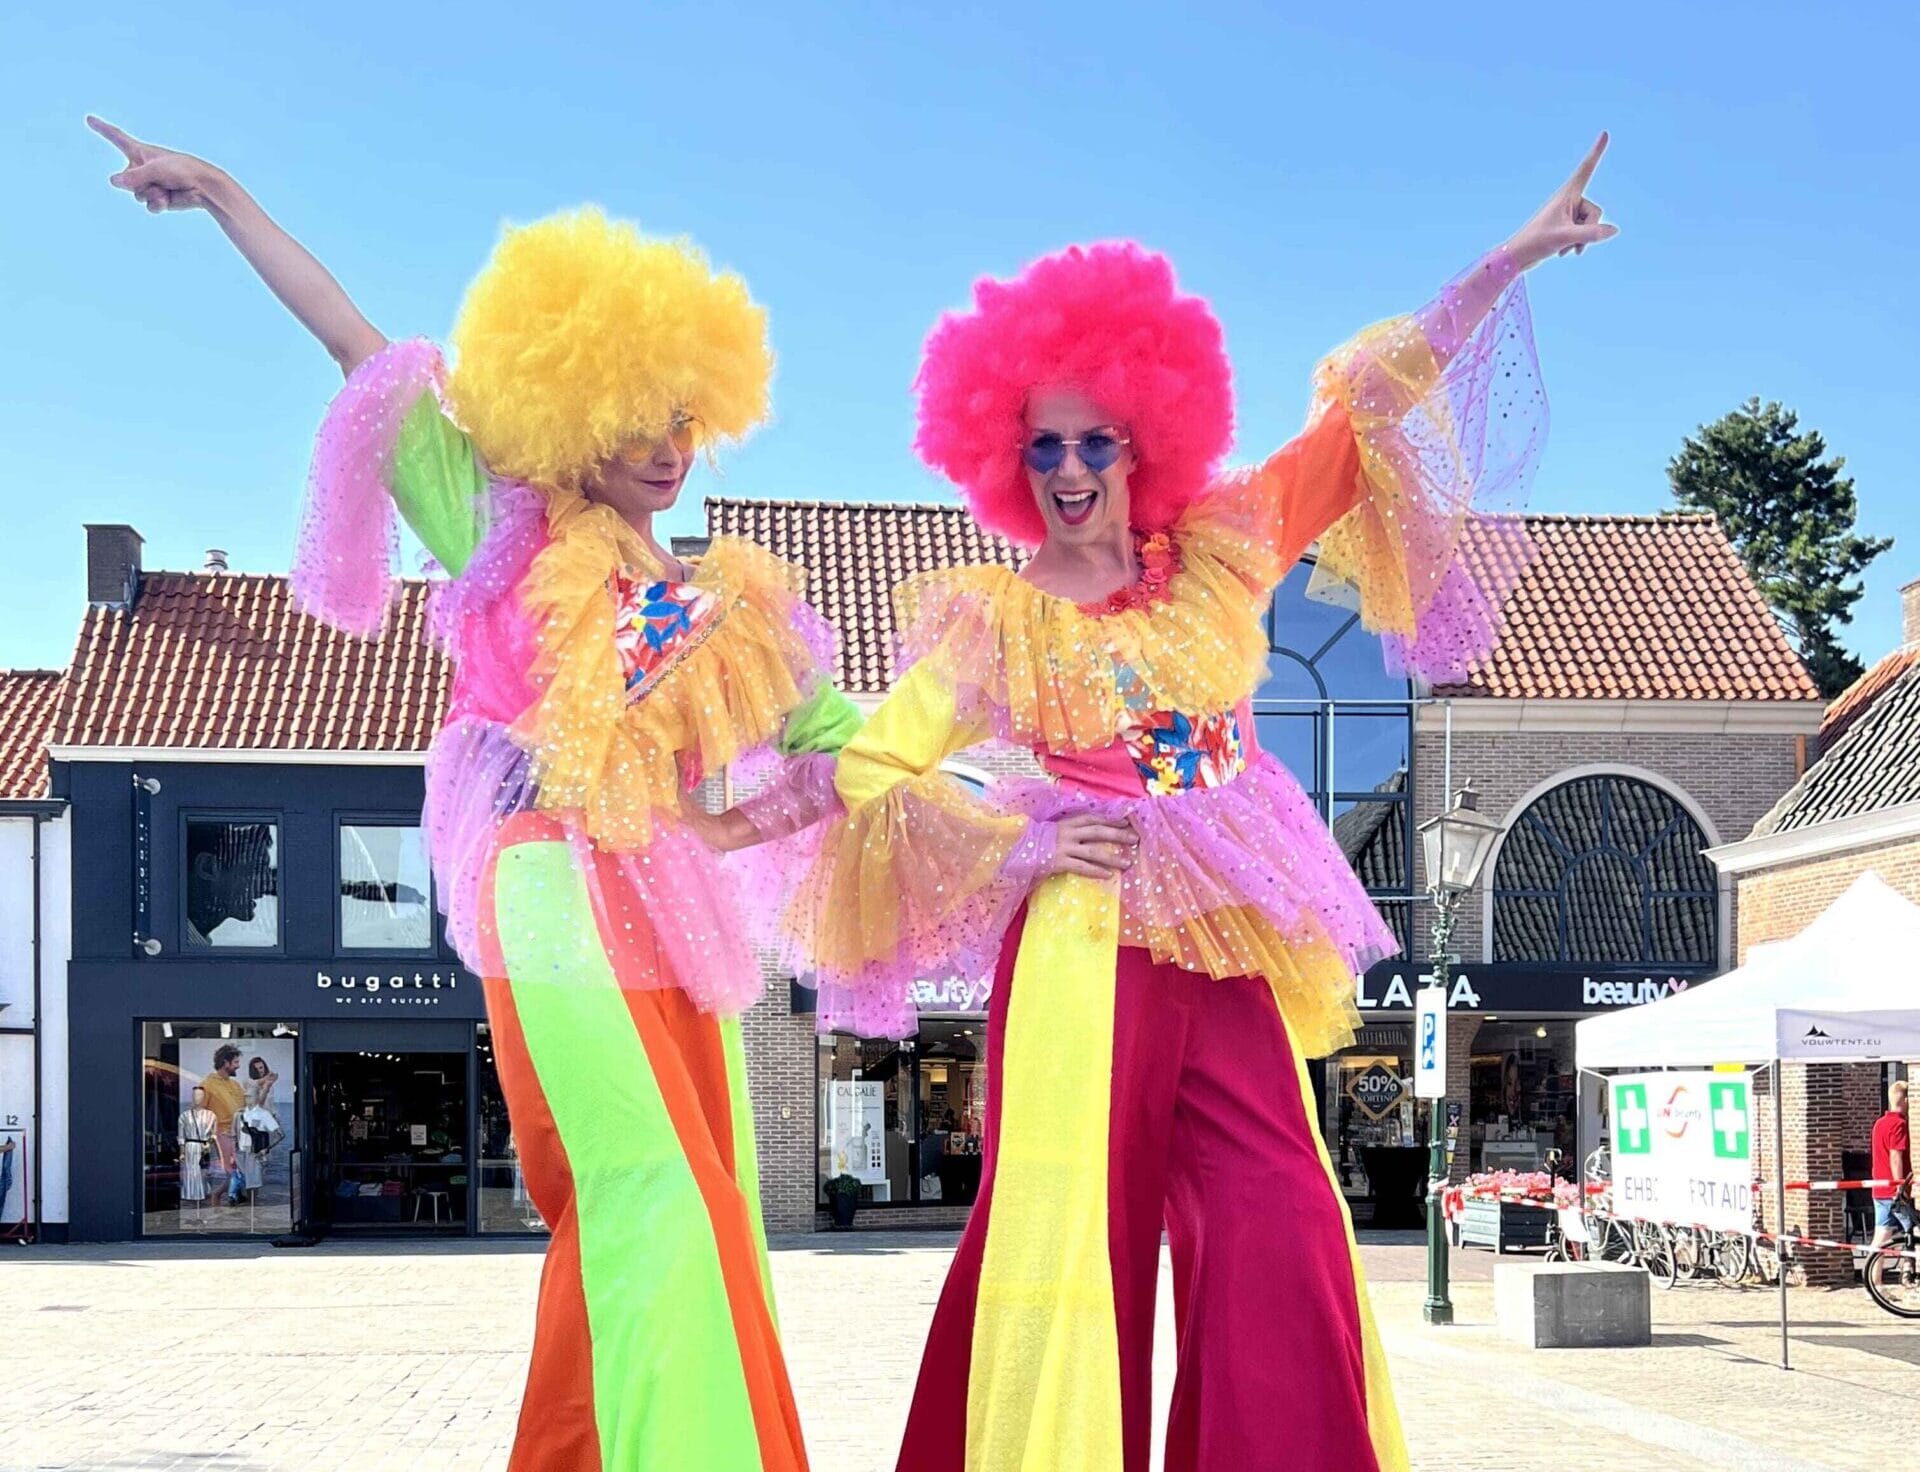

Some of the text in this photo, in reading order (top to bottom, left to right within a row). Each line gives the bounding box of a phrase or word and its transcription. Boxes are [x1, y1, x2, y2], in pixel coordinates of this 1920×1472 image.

[317, 972, 456, 992] bugatti
[335, 997, 439, 1006] we are europe
[1801, 1038, 1881, 1046] VOUWTENT.EU
[1358, 1075, 1398, 1093] 50%
[6, 1114, 18, 1126] 12
[1624, 1175, 1659, 1203] EHB
[1721, 1181, 1749, 1212] AID
